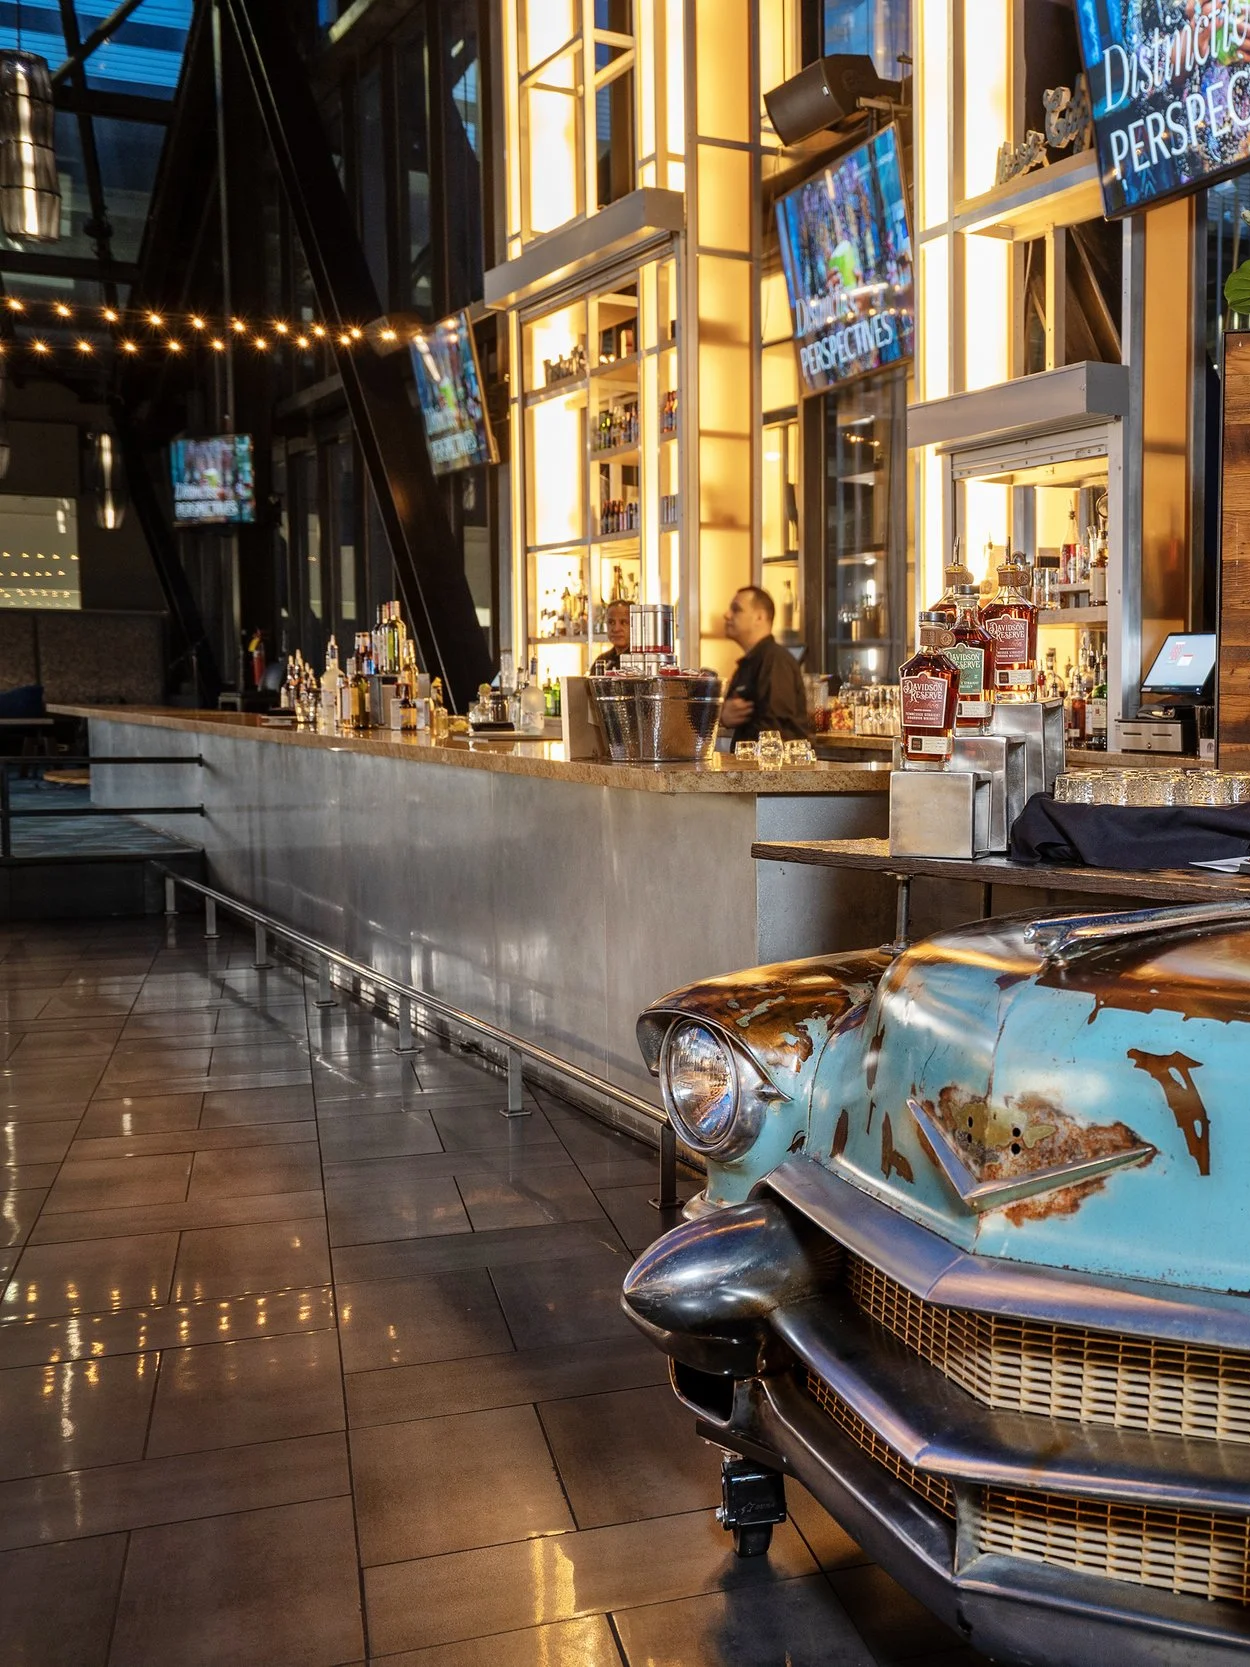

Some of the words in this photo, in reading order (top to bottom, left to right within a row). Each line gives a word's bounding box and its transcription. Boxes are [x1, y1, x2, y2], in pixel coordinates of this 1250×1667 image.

[800, 311, 893, 378] PERSPECTIVES
[989, 622, 1025, 635] DAVIDSON
[996, 631, 1024, 642] RESERVE
[945, 651, 981, 661] DAVIDSON
[955, 660, 981, 669] ESERVE
[903, 680, 943, 694] DAVIDSON
[909, 690, 943, 702] RESERVE
